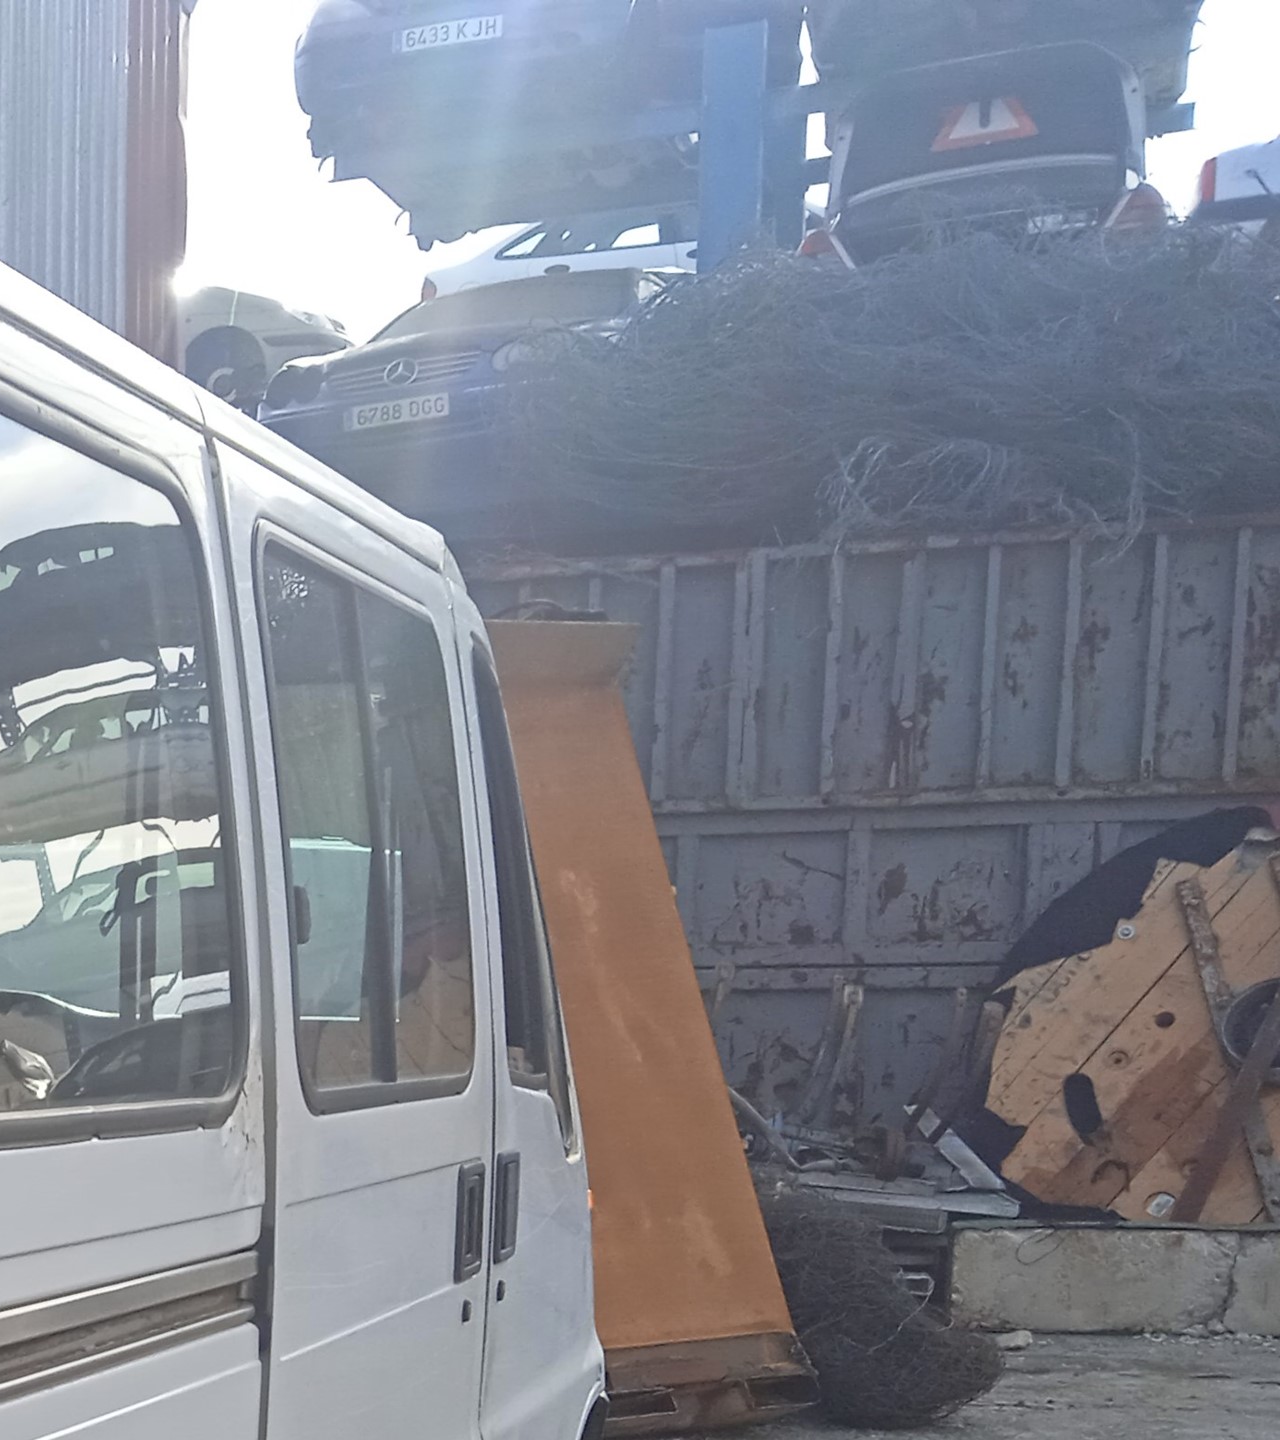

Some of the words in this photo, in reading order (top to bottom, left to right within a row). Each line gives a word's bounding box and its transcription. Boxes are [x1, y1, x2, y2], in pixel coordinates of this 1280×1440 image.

[405, 24, 450, 48] 6433
[456, 18, 497, 40] KJH
[356, 403, 402, 426] 6788
